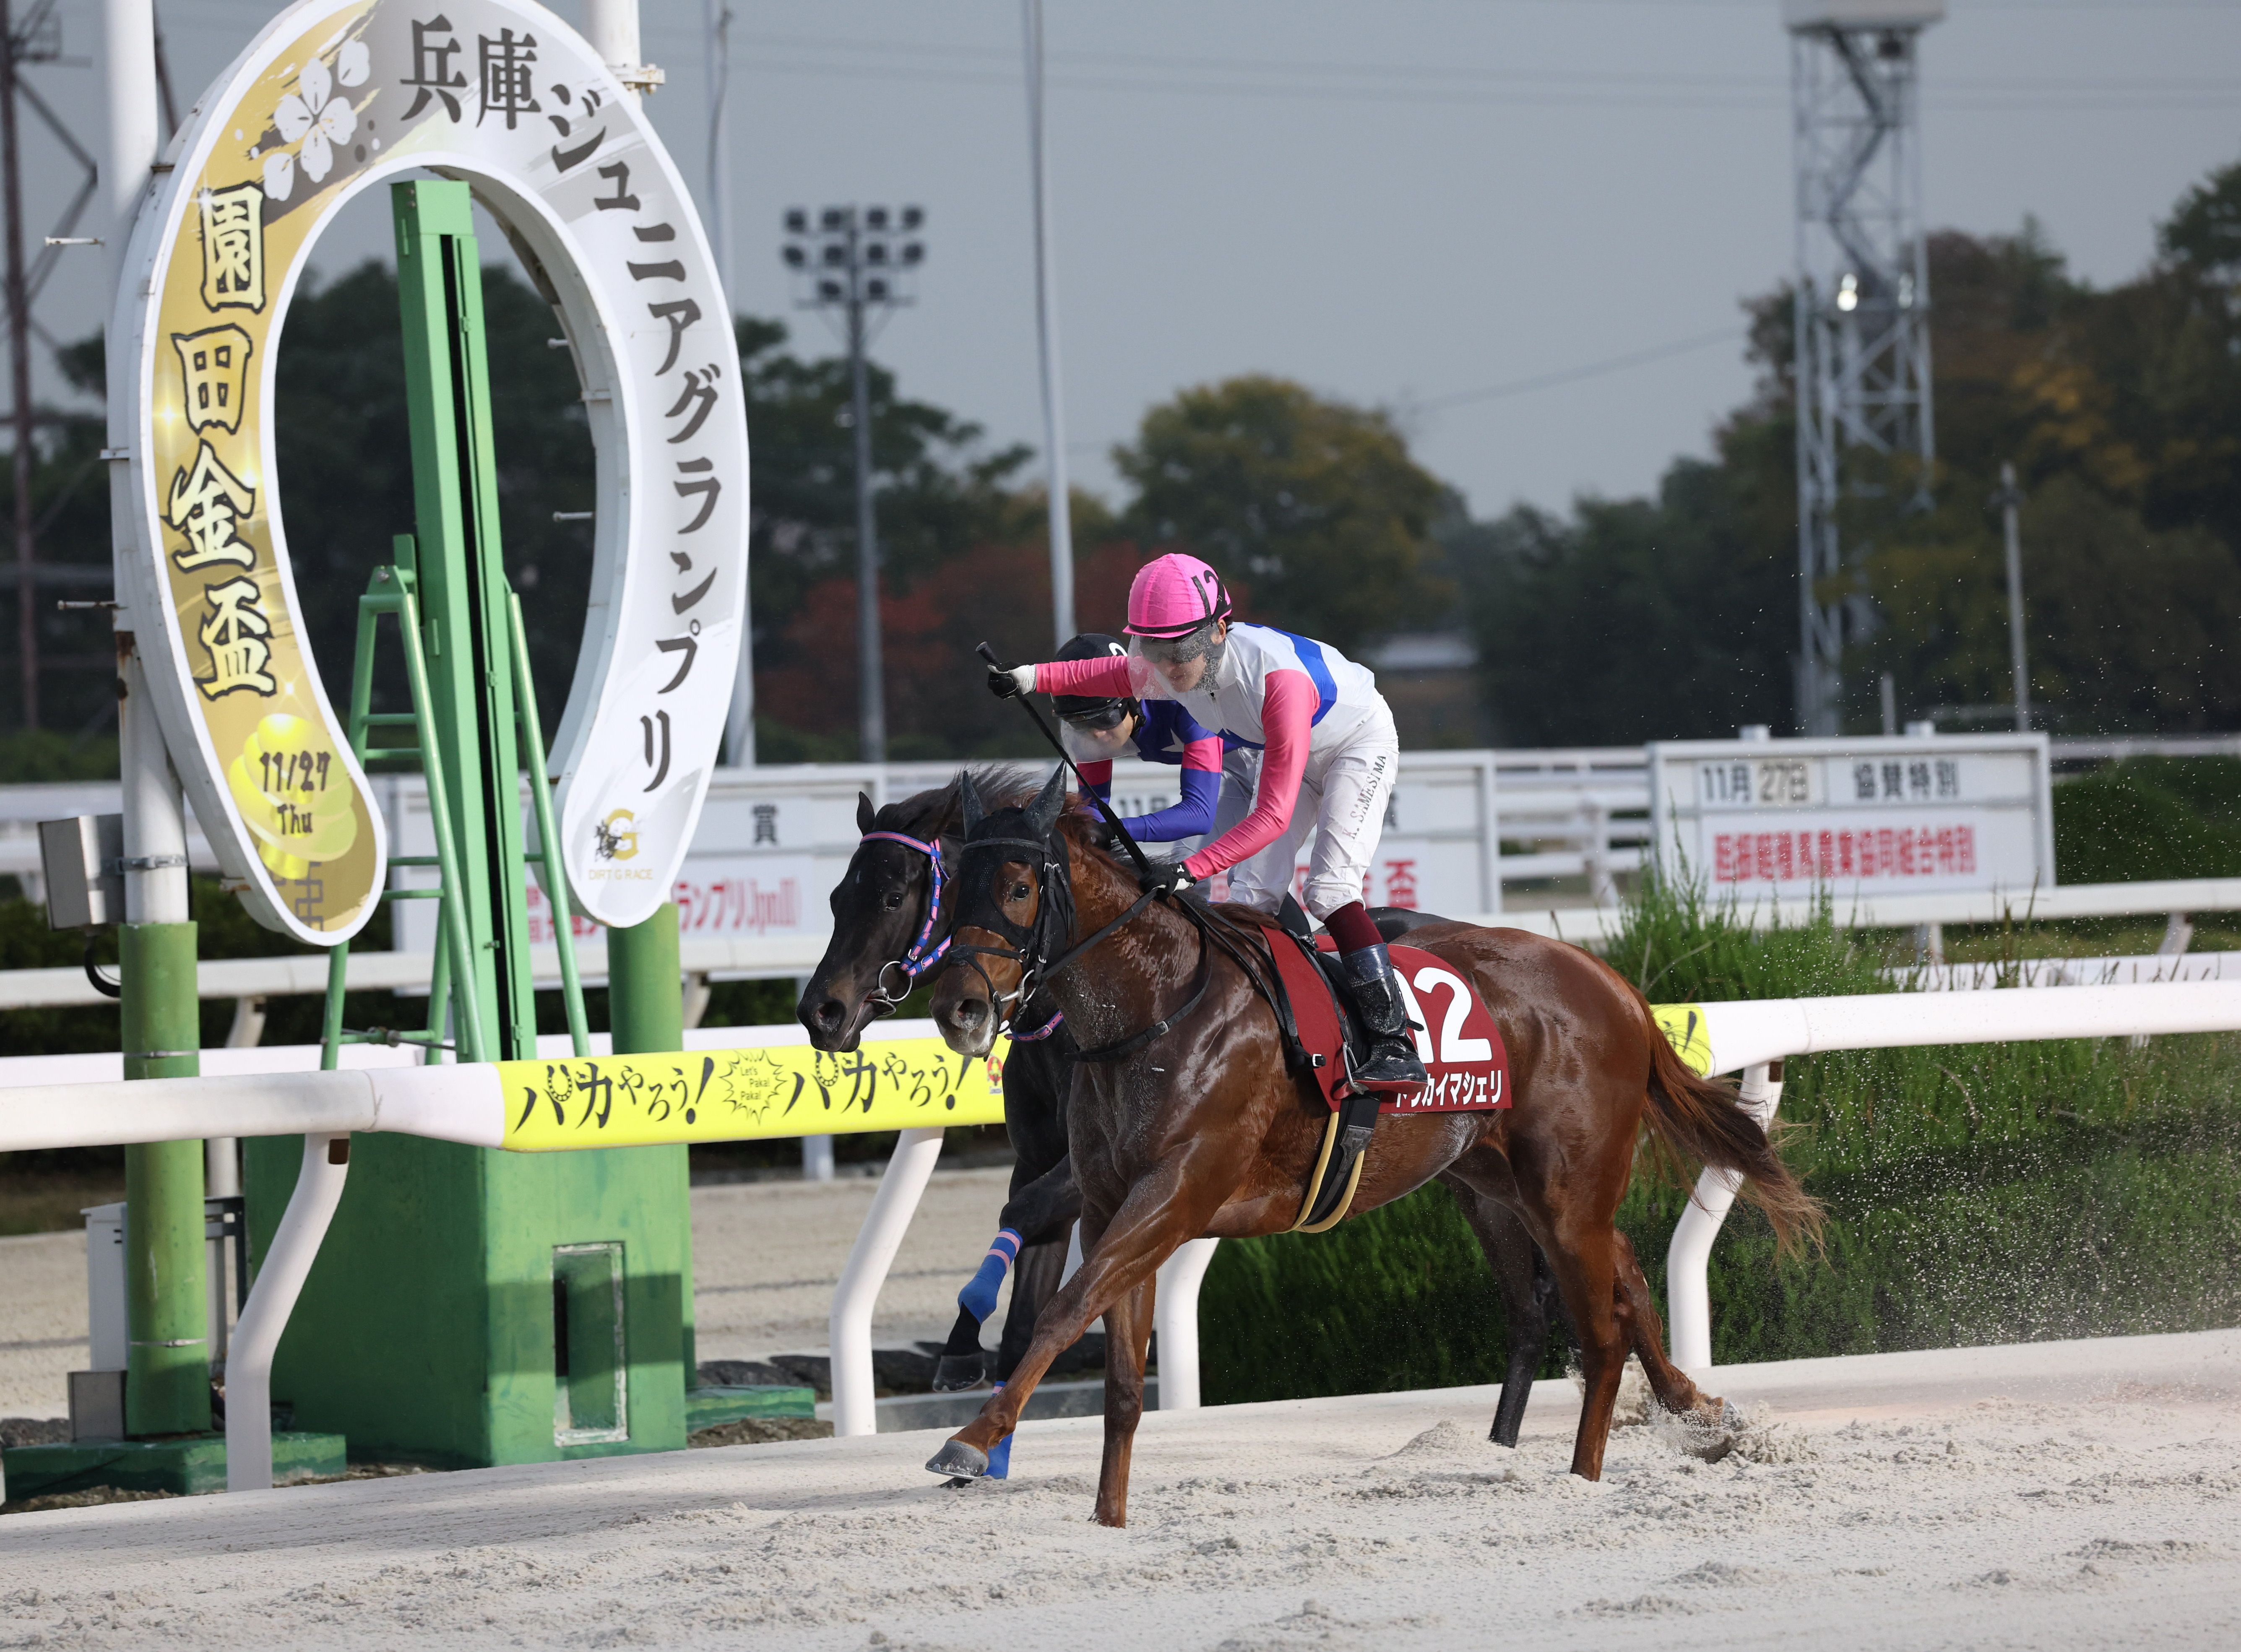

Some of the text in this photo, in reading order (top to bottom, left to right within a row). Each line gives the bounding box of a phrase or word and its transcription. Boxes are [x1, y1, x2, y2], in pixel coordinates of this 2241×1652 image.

[400, 13, 722, 792] 兵庫ジュニアグランプリ
[161, 181, 276, 702] 園田金盃
[260, 751, 331, 791] 11/27
[277, 804, 313, 835] Thu
[588, 869, 653, 880] DIRT G RACE
[740, 1066, 758, 1076] Let's
